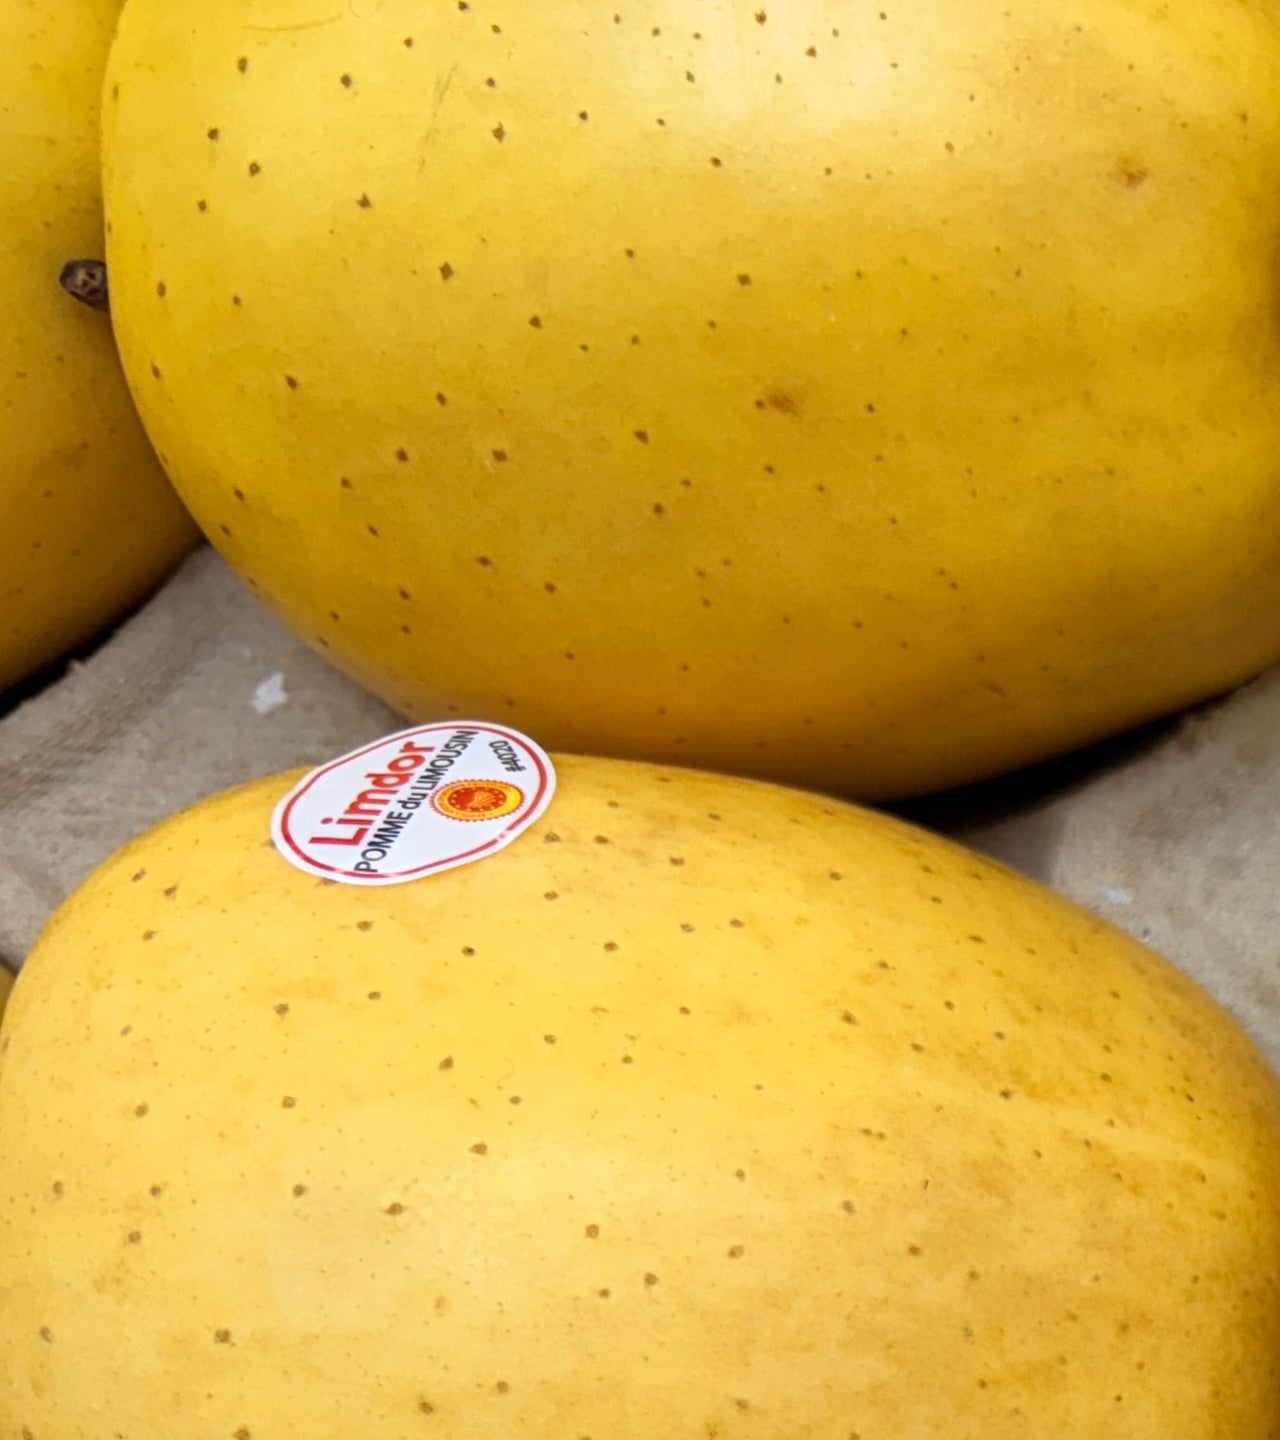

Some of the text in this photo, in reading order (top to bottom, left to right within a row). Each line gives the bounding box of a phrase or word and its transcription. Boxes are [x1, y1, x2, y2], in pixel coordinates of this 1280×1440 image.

[308, 741, 436, 846] Limdor
[354, 811, 413, 872] POMME
[398, 792, 427, 811] du
[415, 730, 479, 793] LIMOUSIN
[488, 740, 526, 772] #4020
